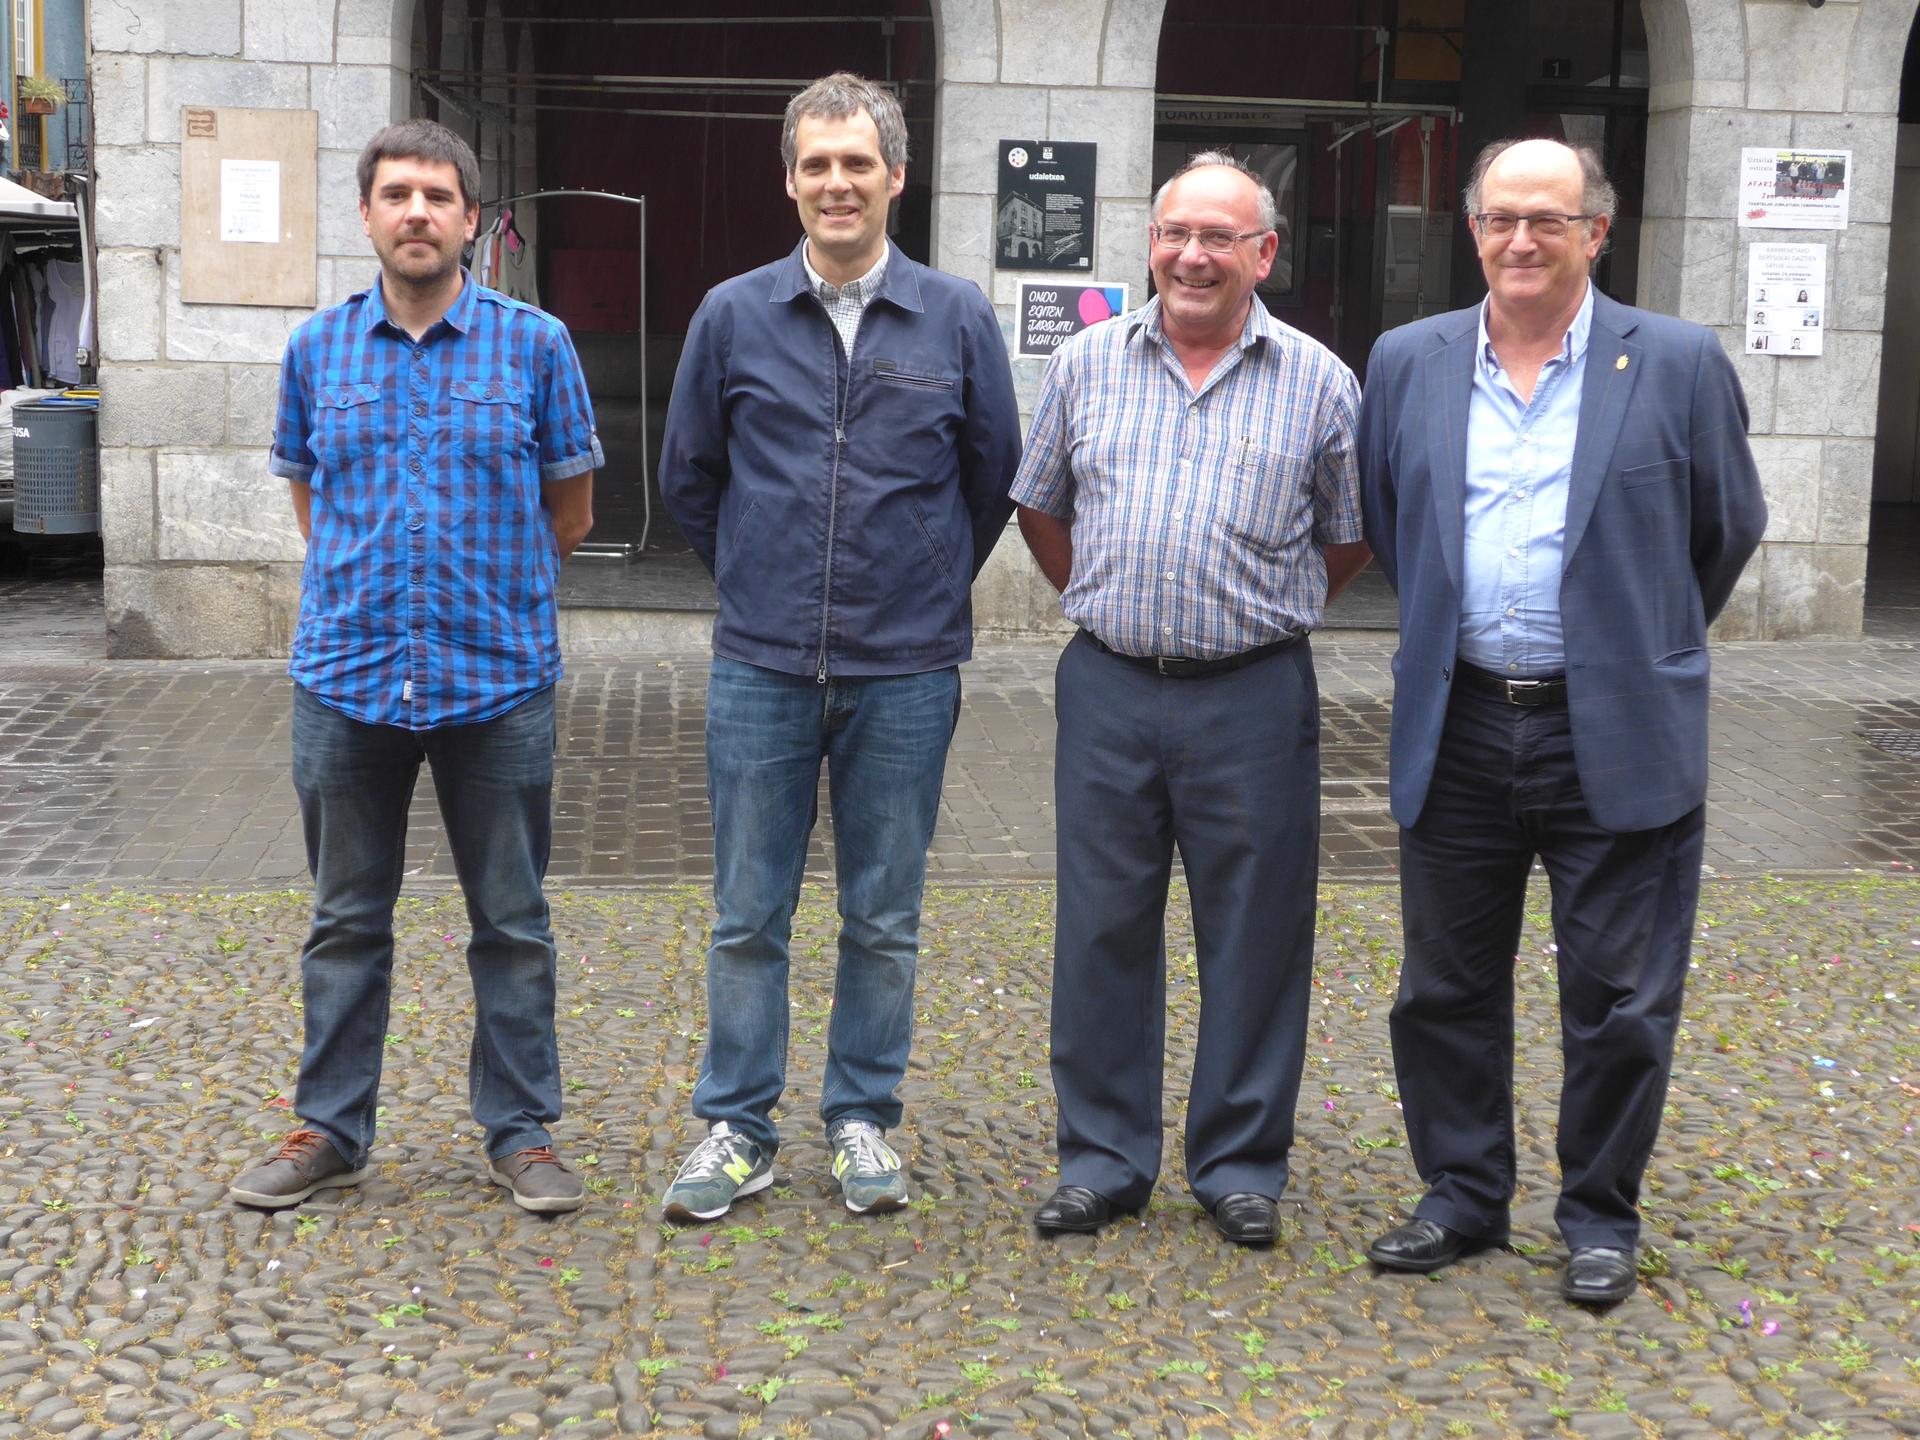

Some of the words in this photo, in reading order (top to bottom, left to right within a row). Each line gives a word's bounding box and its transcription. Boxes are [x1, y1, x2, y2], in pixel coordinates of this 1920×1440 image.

[1552, 61, 1560, 77] 1
[1029, 172, 1065, 181] udaletxea
[1028, 290, 1058, 303] ONDO
[1028, 305, 1064, 319] EGITEN
[1027, 320, 1075, 333] JARRAITU
[1026, 334, 1051, 347] NAHI
